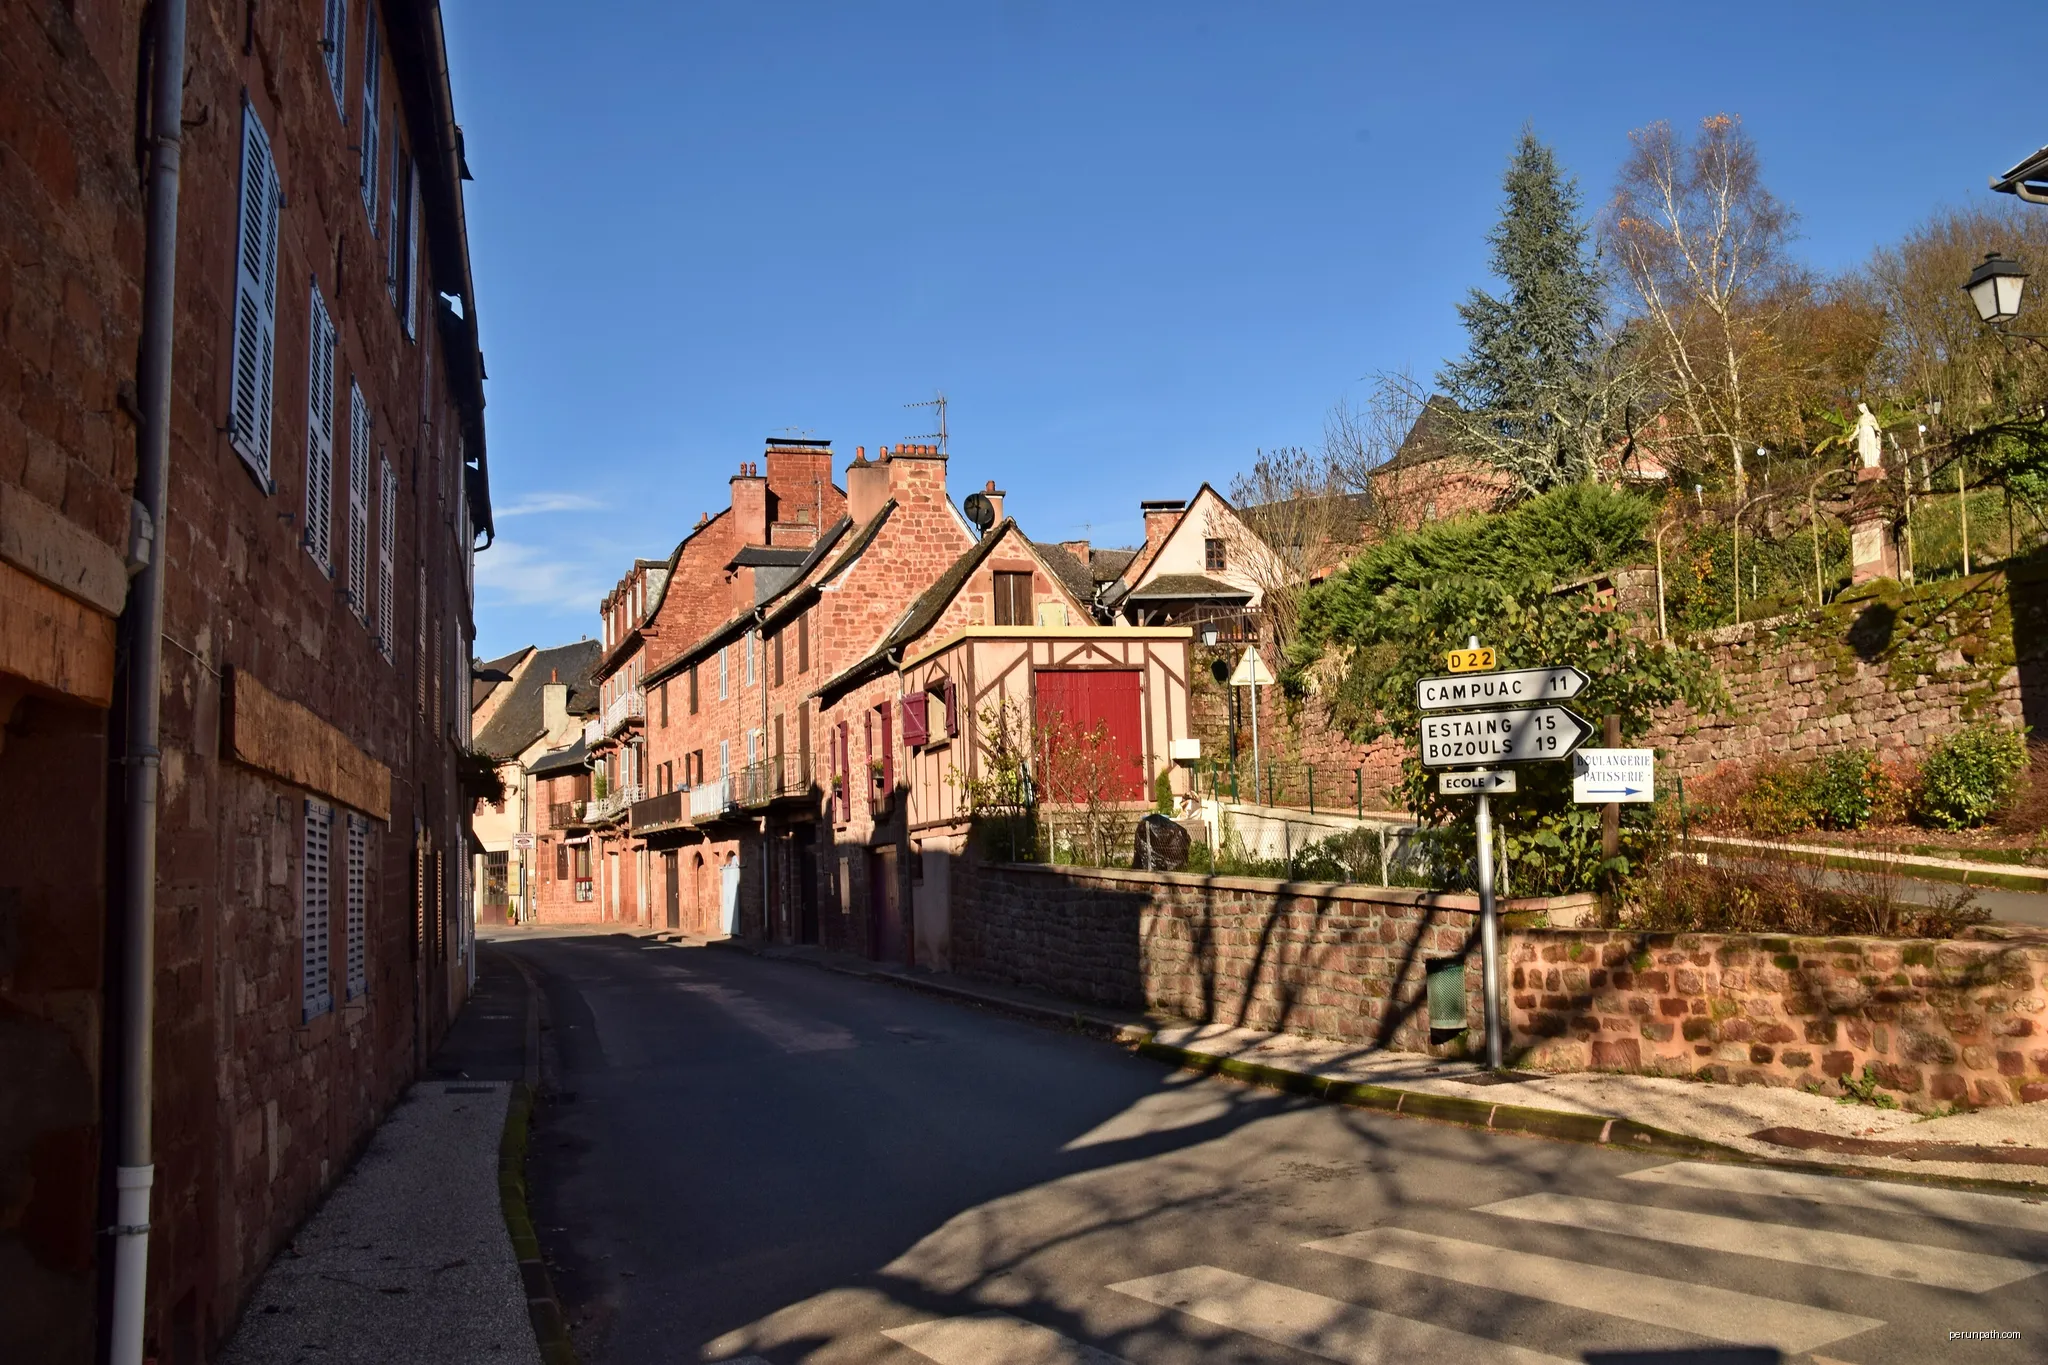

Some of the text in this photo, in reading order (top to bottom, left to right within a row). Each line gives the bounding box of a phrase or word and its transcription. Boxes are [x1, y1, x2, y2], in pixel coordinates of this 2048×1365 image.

[1451, 652, 1492, 668] D 22
[1426, 676, 1567, 701] CAMPUAC 11
[1428, 715, 1556, 738] ESTAING 15
[1429, 736, 1557, 758] BOZOULS 19
[1577, 755, 1650, 766] BOULANGERIE
[1446, 777, 1485, 789] ECOLE
[1583, 771, 1644, 782] PATISSERIE
